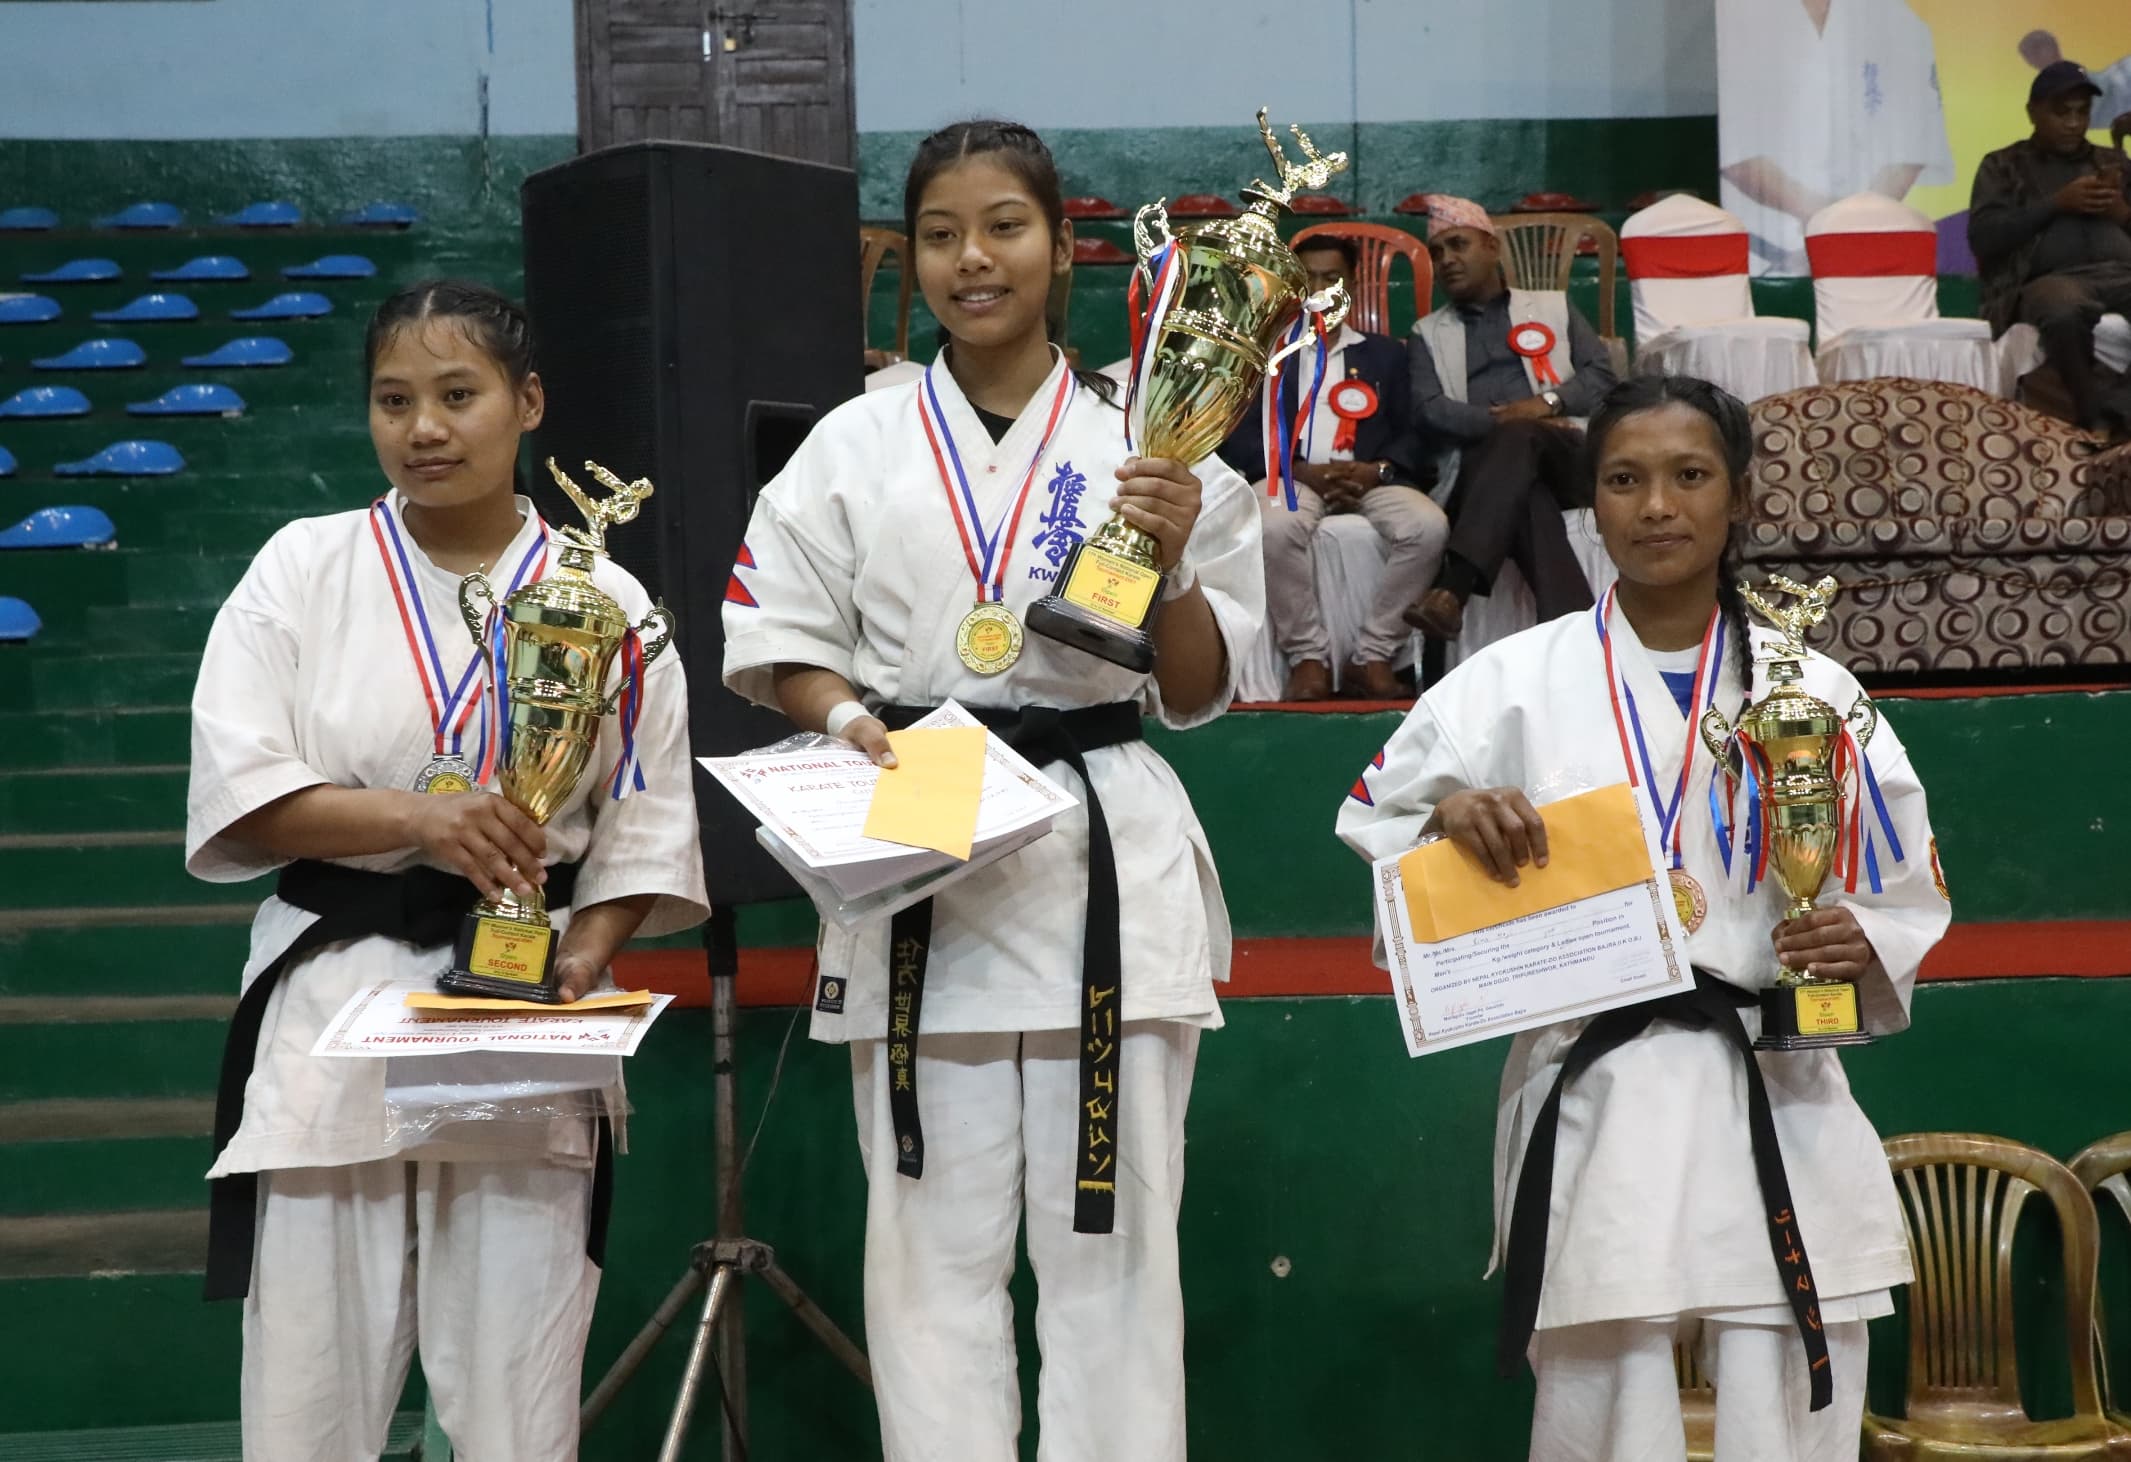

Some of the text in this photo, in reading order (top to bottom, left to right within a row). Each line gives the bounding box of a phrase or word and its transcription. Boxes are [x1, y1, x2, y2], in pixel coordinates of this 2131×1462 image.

[1028, 566, 1059, 582] KW
[1092, 592, 1120, 608] FIRST
[768, 760, 841, 773] NATIONAL
[788, 782, 844, 793] KARATE
[488, 958, 527, 971] SECOND
[1430, 980, 1462, 993] ORGANIZED
[1558, 947, 1596, 960] ASSOCIATION
[399, 1016, 514, 1024] TOURNAMENT
[361, 1034, 572, 1045] NATIONAL TOURNAMENT
